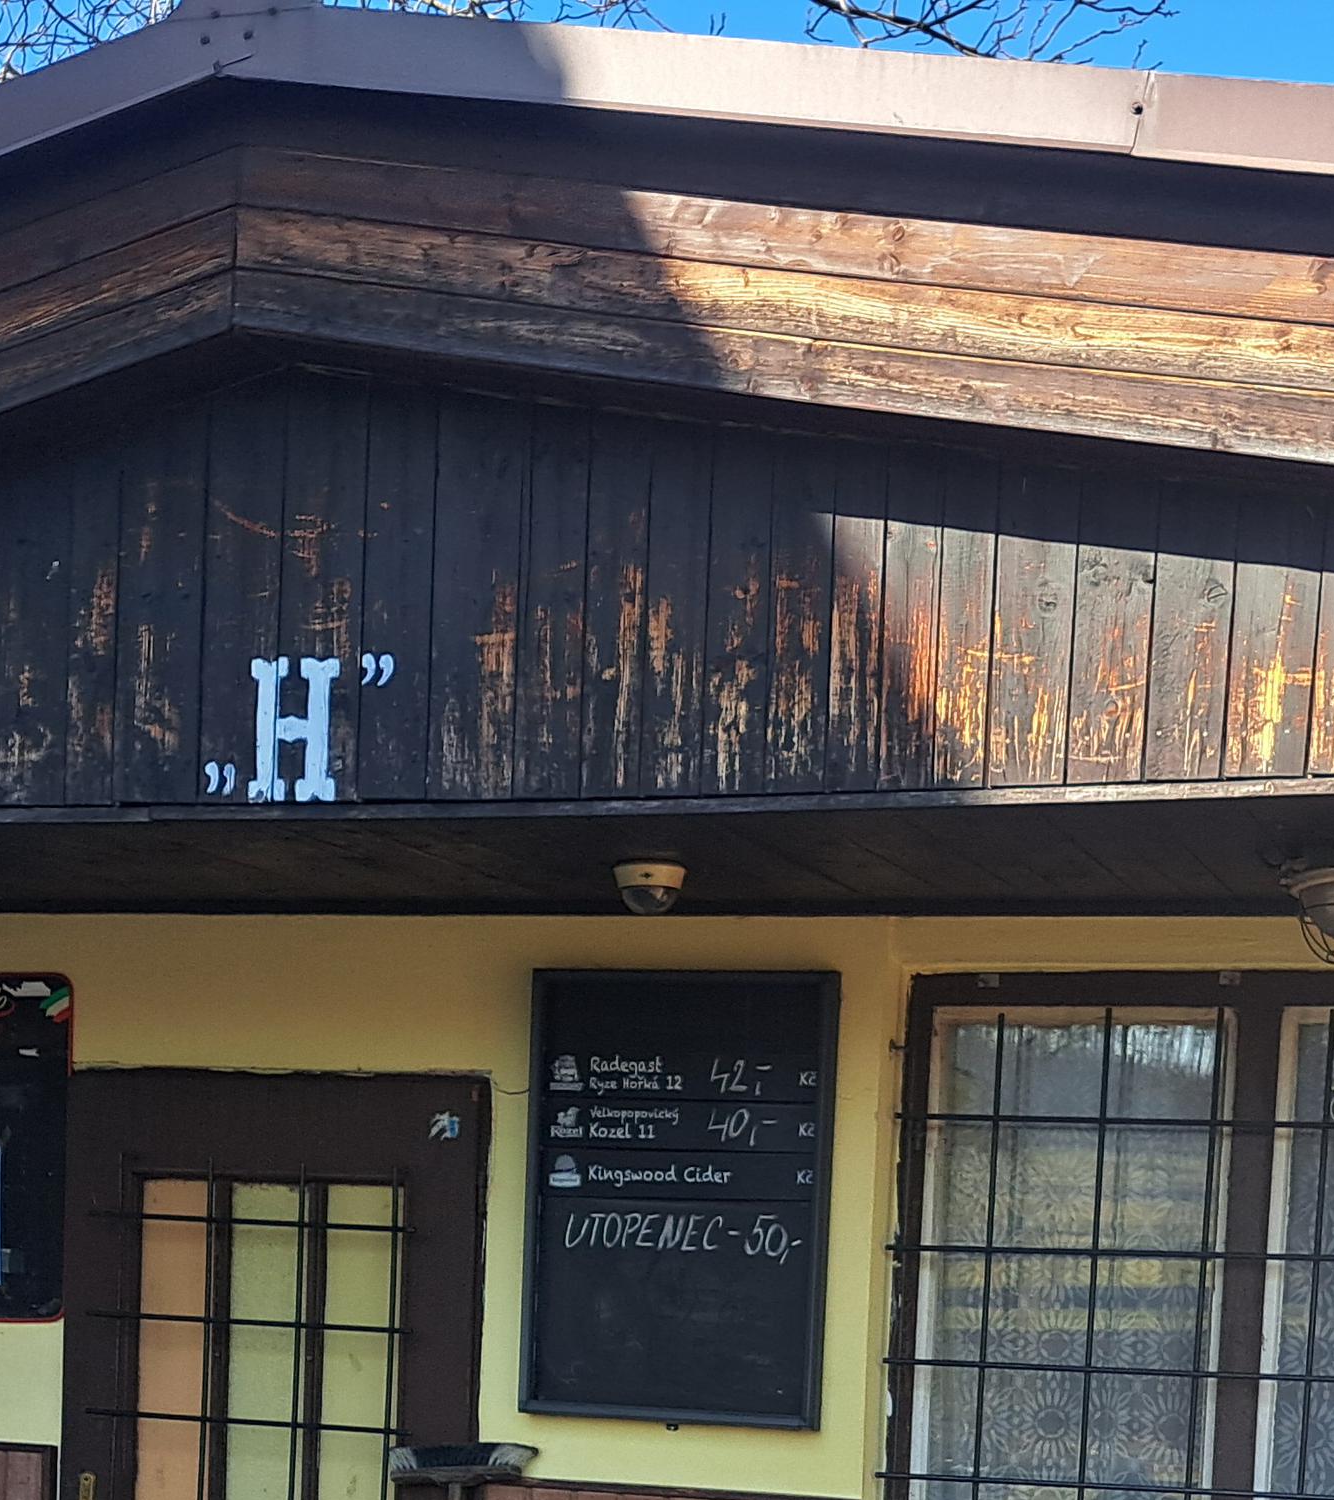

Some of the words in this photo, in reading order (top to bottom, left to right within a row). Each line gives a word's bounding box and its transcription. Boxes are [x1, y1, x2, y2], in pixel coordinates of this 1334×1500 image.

[589, 1054, 663, 1078] Radegast
[588, 1076, 618, 1096] Ryze
[622, 1074, 660, 1090] Hořká
[665, 1074, 684, 1091] 12
[798, 1070, 818, 1086] Kč
[589, 1105, 680, 1126] Velkopopovický
[588, 1121, 632, 1139] Kozel
[637, 1123, 657, 1139] 11
[797, 1121, 817, 1137] Kč
[587, 1164, 678, 1188] Kingswood
[683, 1164, 732, 1184] Cider
[795, 1170, 814, 1185] Kč
